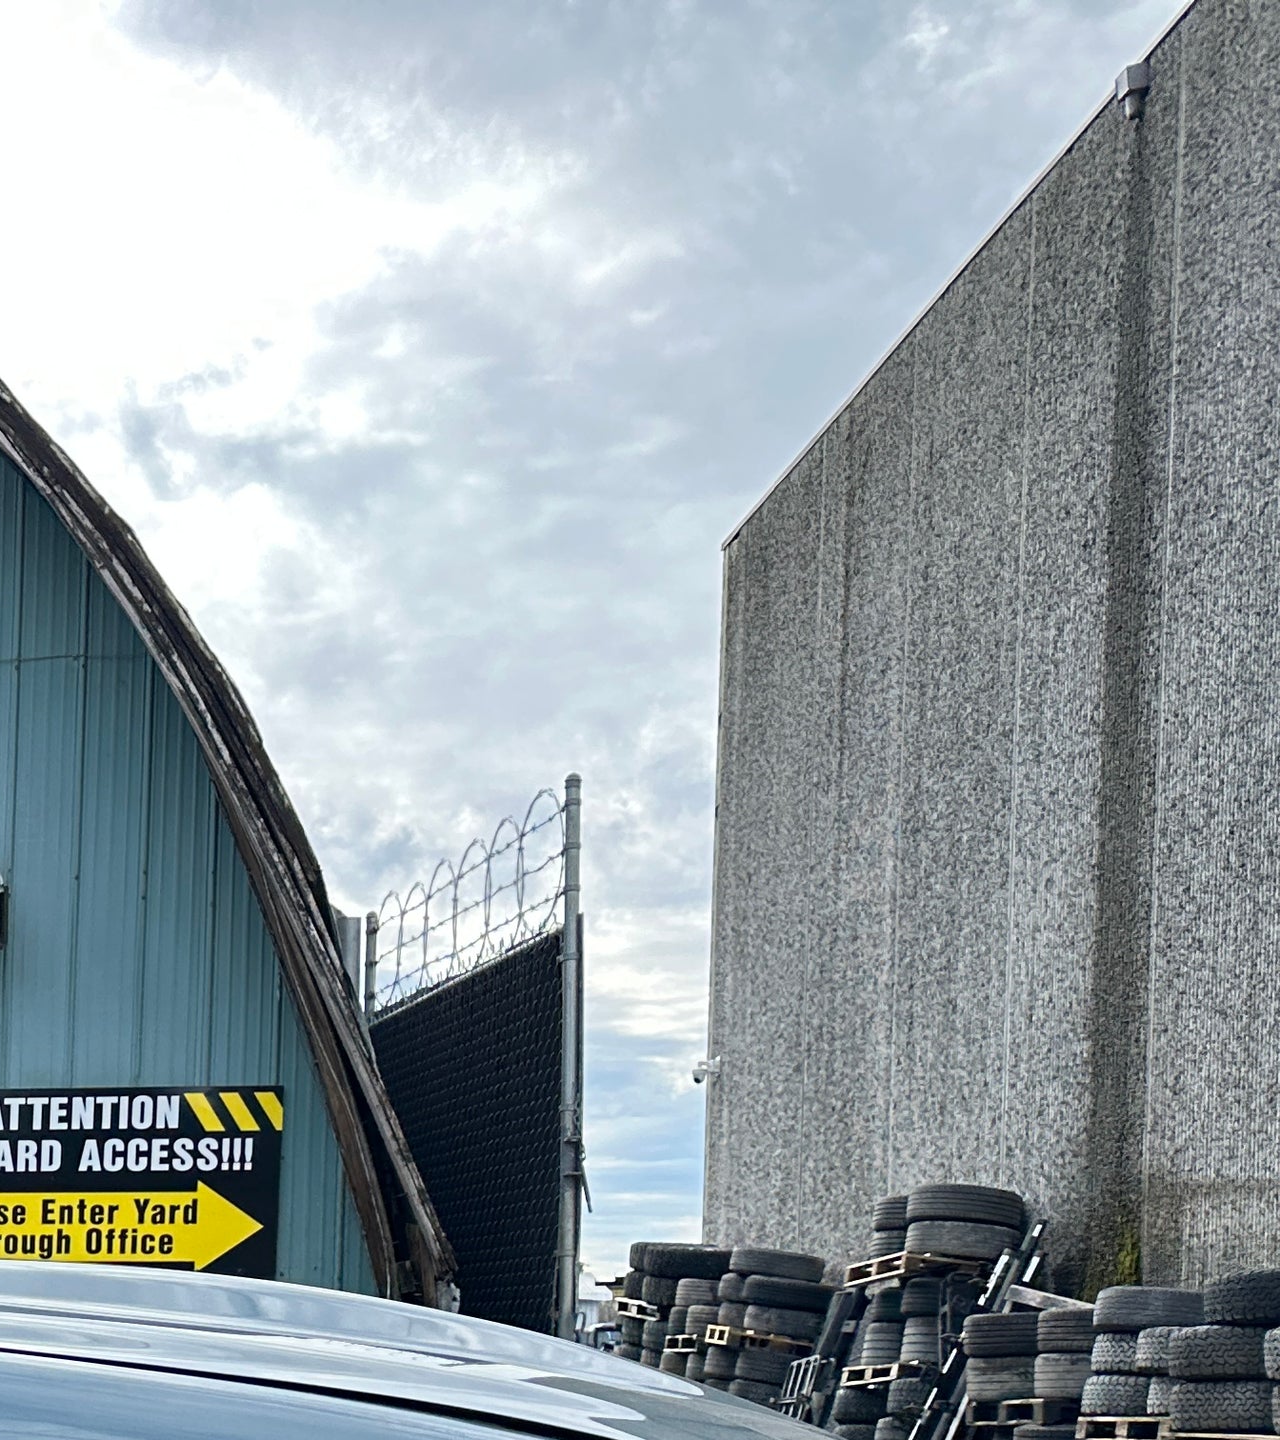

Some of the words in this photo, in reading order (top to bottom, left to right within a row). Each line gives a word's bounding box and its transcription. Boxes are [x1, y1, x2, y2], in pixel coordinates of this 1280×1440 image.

[78, 1137, 254, 1172] ACCESS!!!
[40, 1198, 119, 1225] Enter
[134, 1198, 198, 1225] Yard
[85, 1228, 174, 1255] Office
